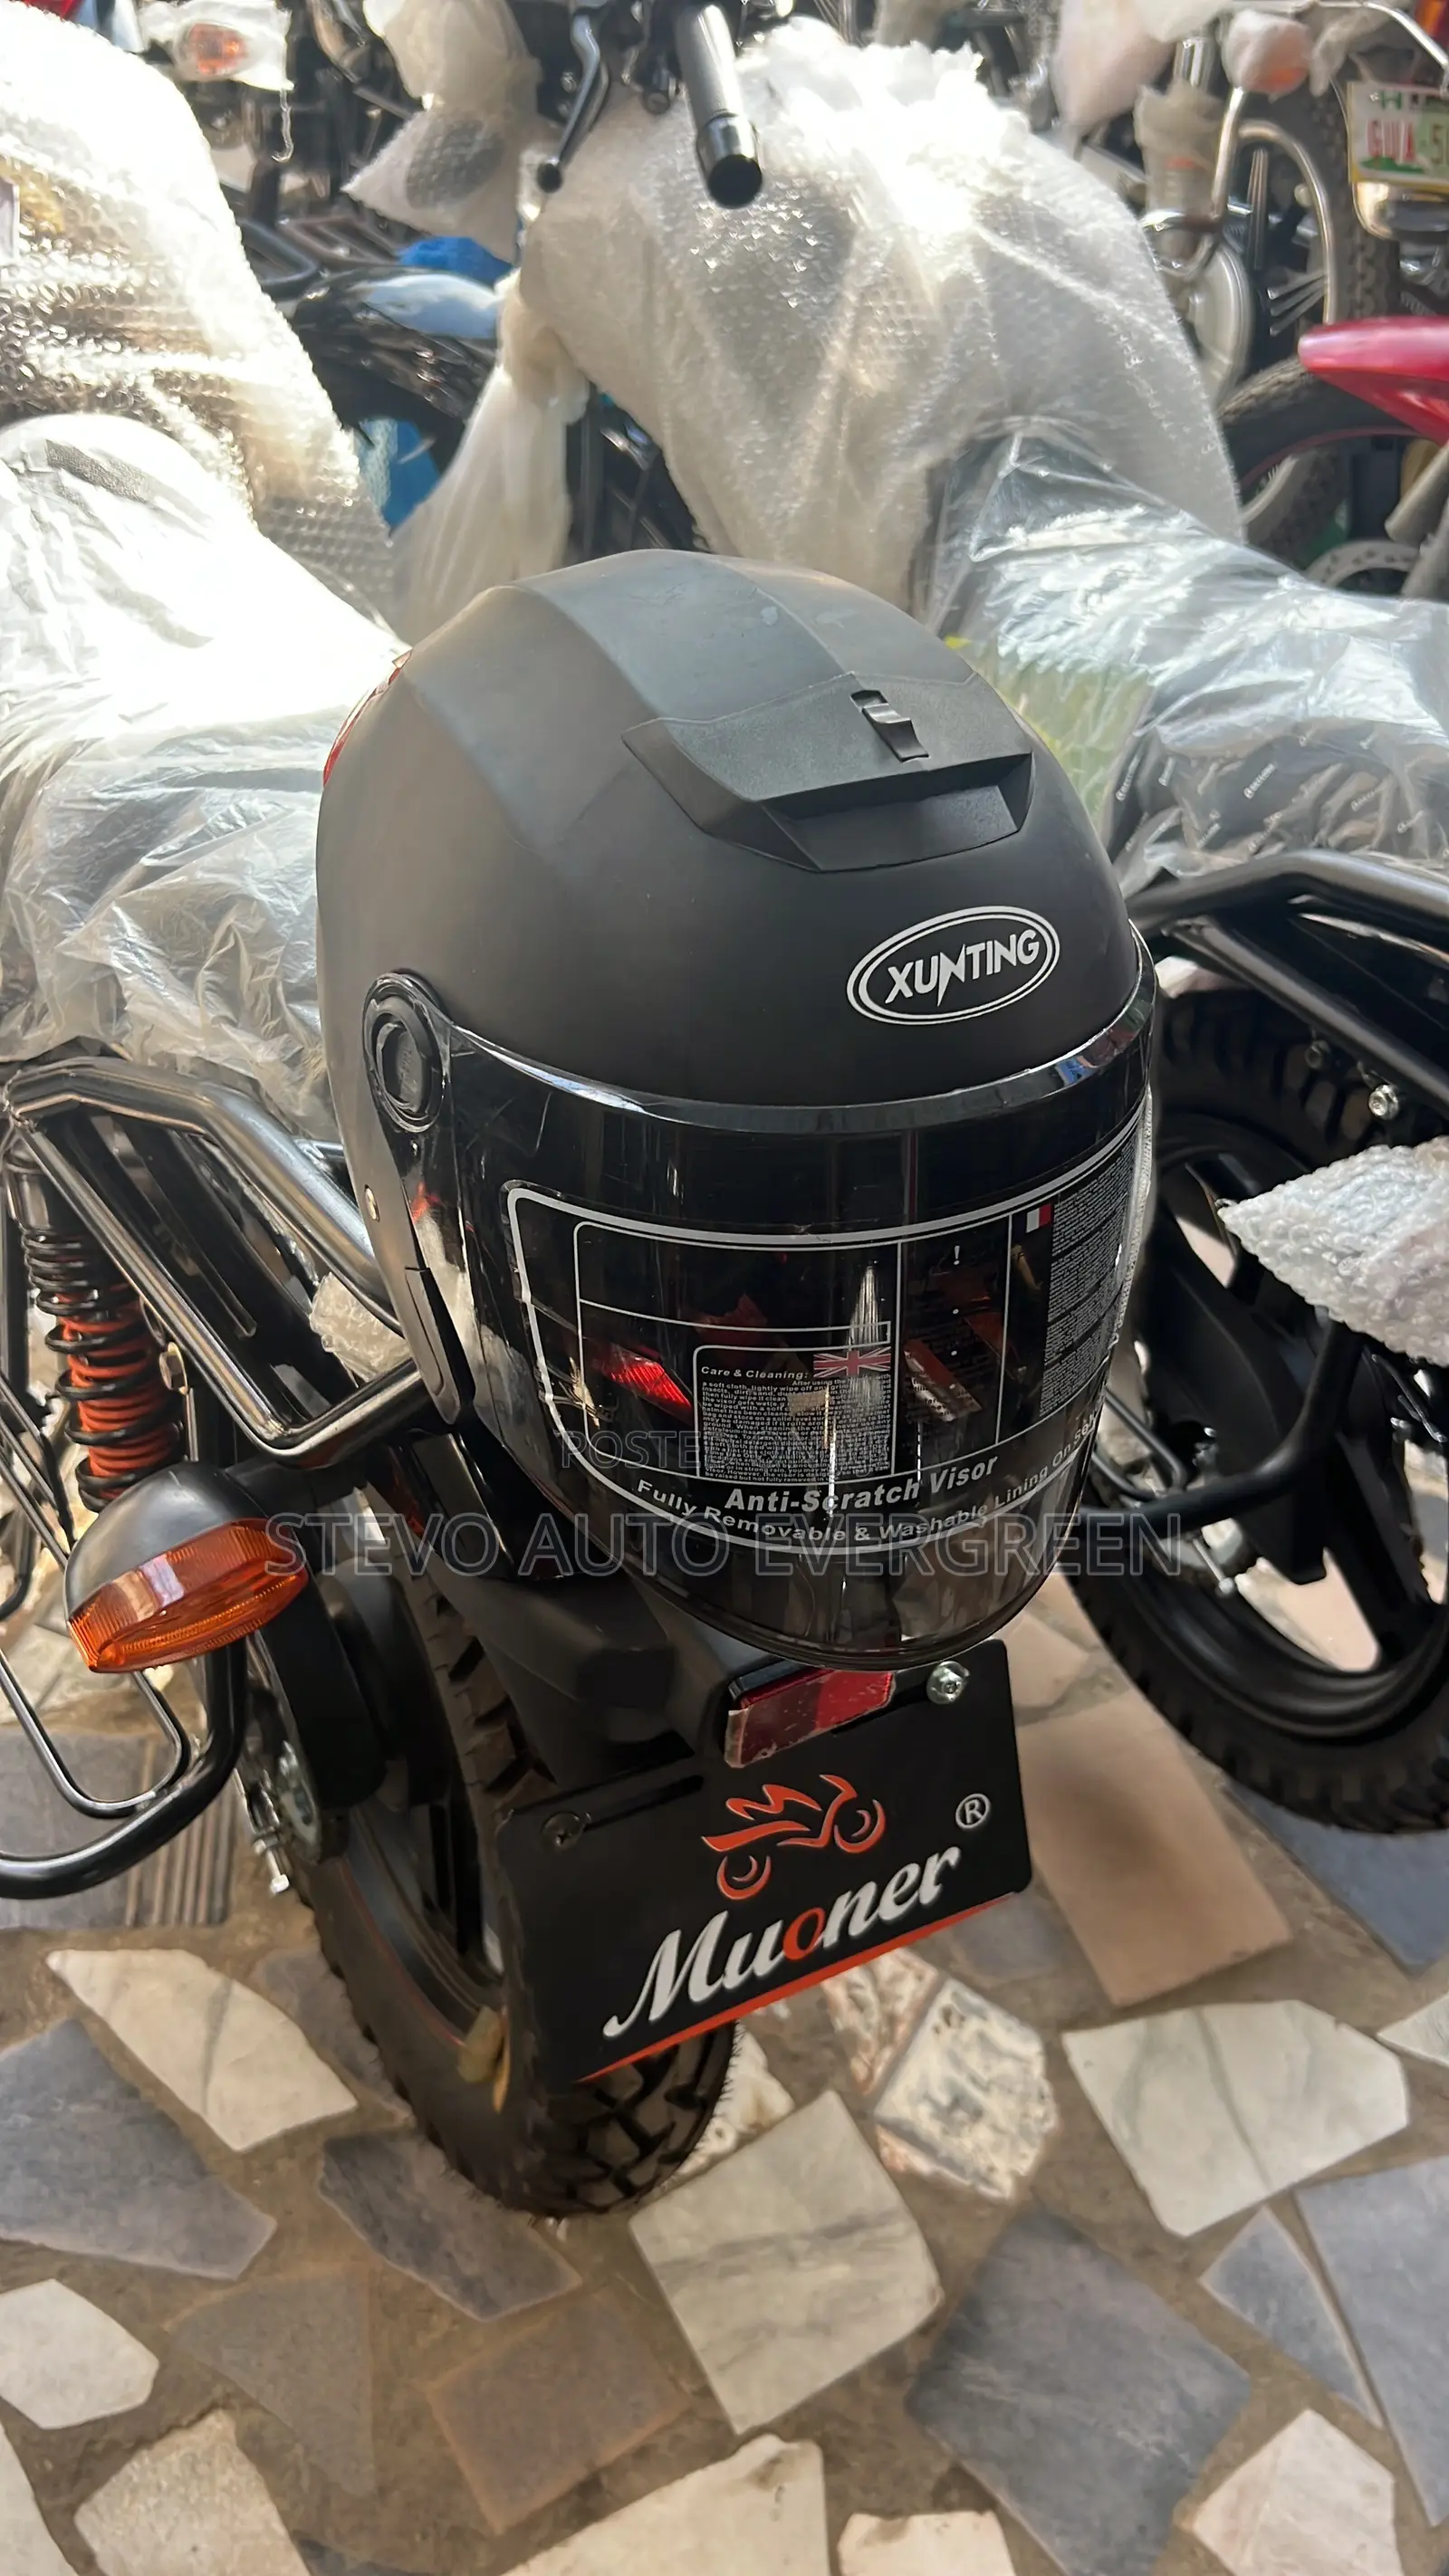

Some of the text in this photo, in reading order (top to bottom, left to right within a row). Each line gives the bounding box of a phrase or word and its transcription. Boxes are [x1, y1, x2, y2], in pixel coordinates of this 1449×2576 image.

[885, 929, 1040, 1008] XUNTING
[701, 1366, 808, 1380] Care & Cleaning:
[637, 1479, 697, 1517] Fully
[704, 1506, 847, 1541] Removable
[854, 1525, 871, 1542] &
[879, 1504, 988, 1540] Washable
[995, 1466, 1049, 1509] Lining
[1052, 1443, 1071, 1467] On
[724, 1455, 999, 1512] Anti-Scratch Visor
[602, 1846, 961, 2038] Muoner
